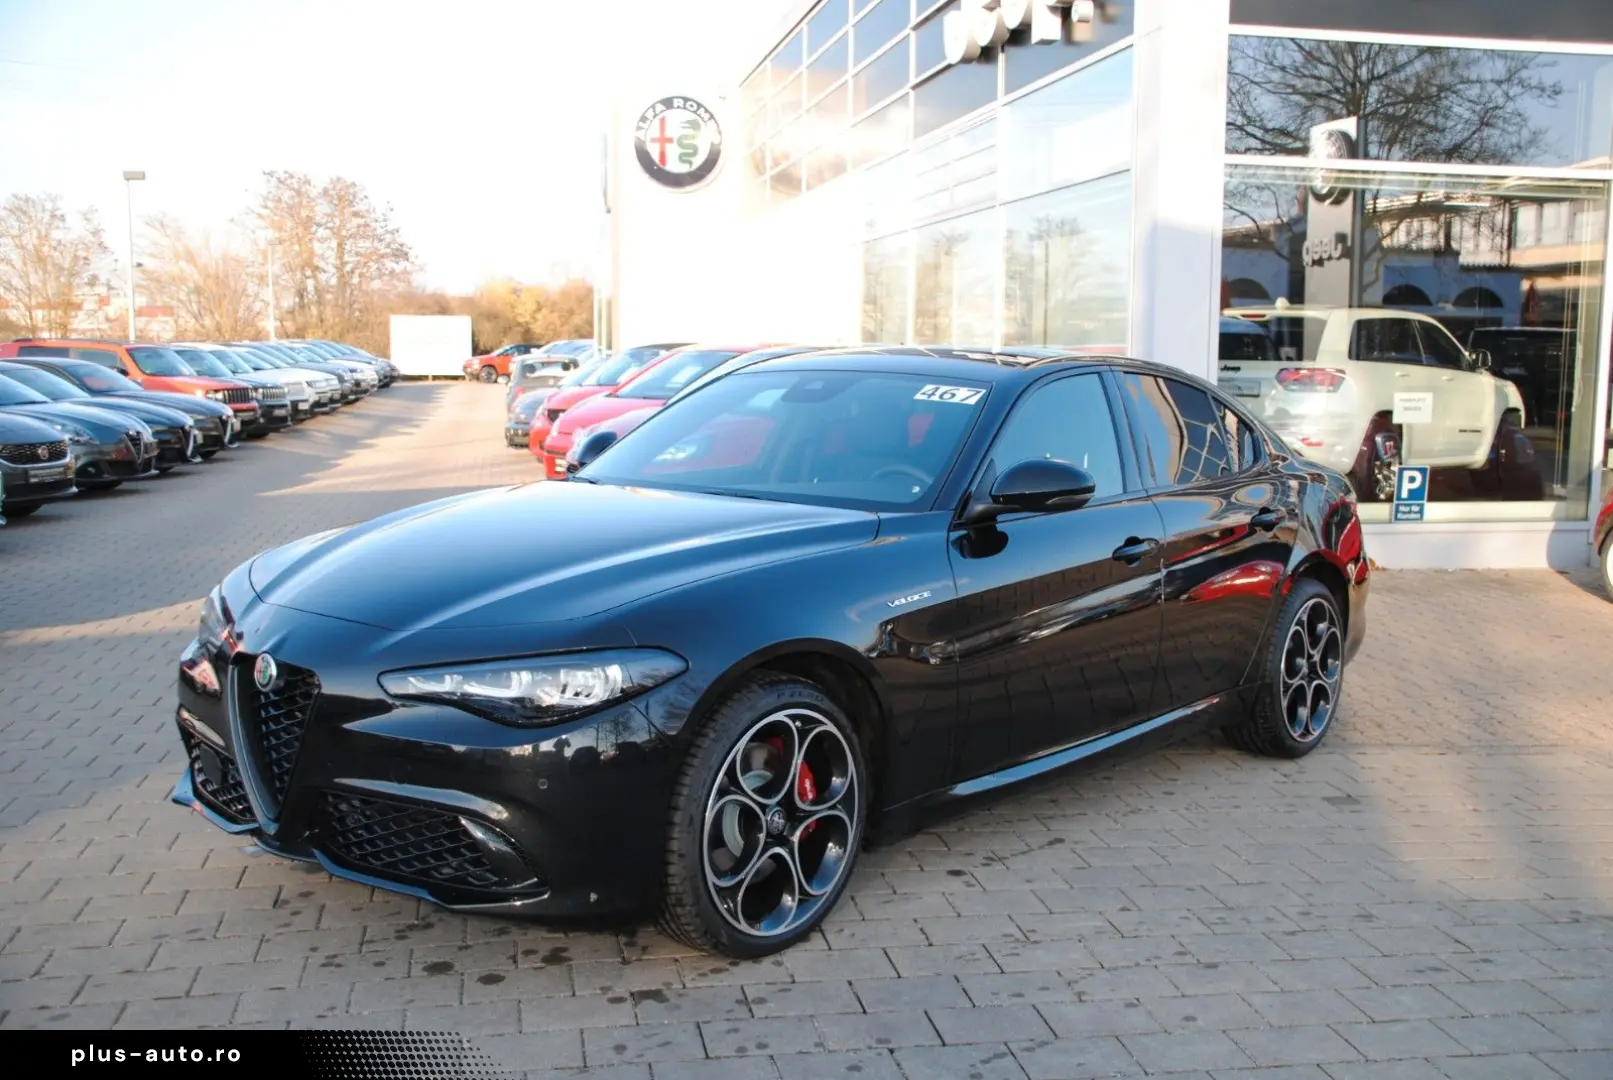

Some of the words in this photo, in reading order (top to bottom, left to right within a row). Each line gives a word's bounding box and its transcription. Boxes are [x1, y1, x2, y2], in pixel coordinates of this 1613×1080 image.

[1220, 364, 1241, 374] Jeep
[919, 386, 983, 402] 467
[1401, 470, 1422, 499] P
[886, 590, 931, 608] VELOCE
